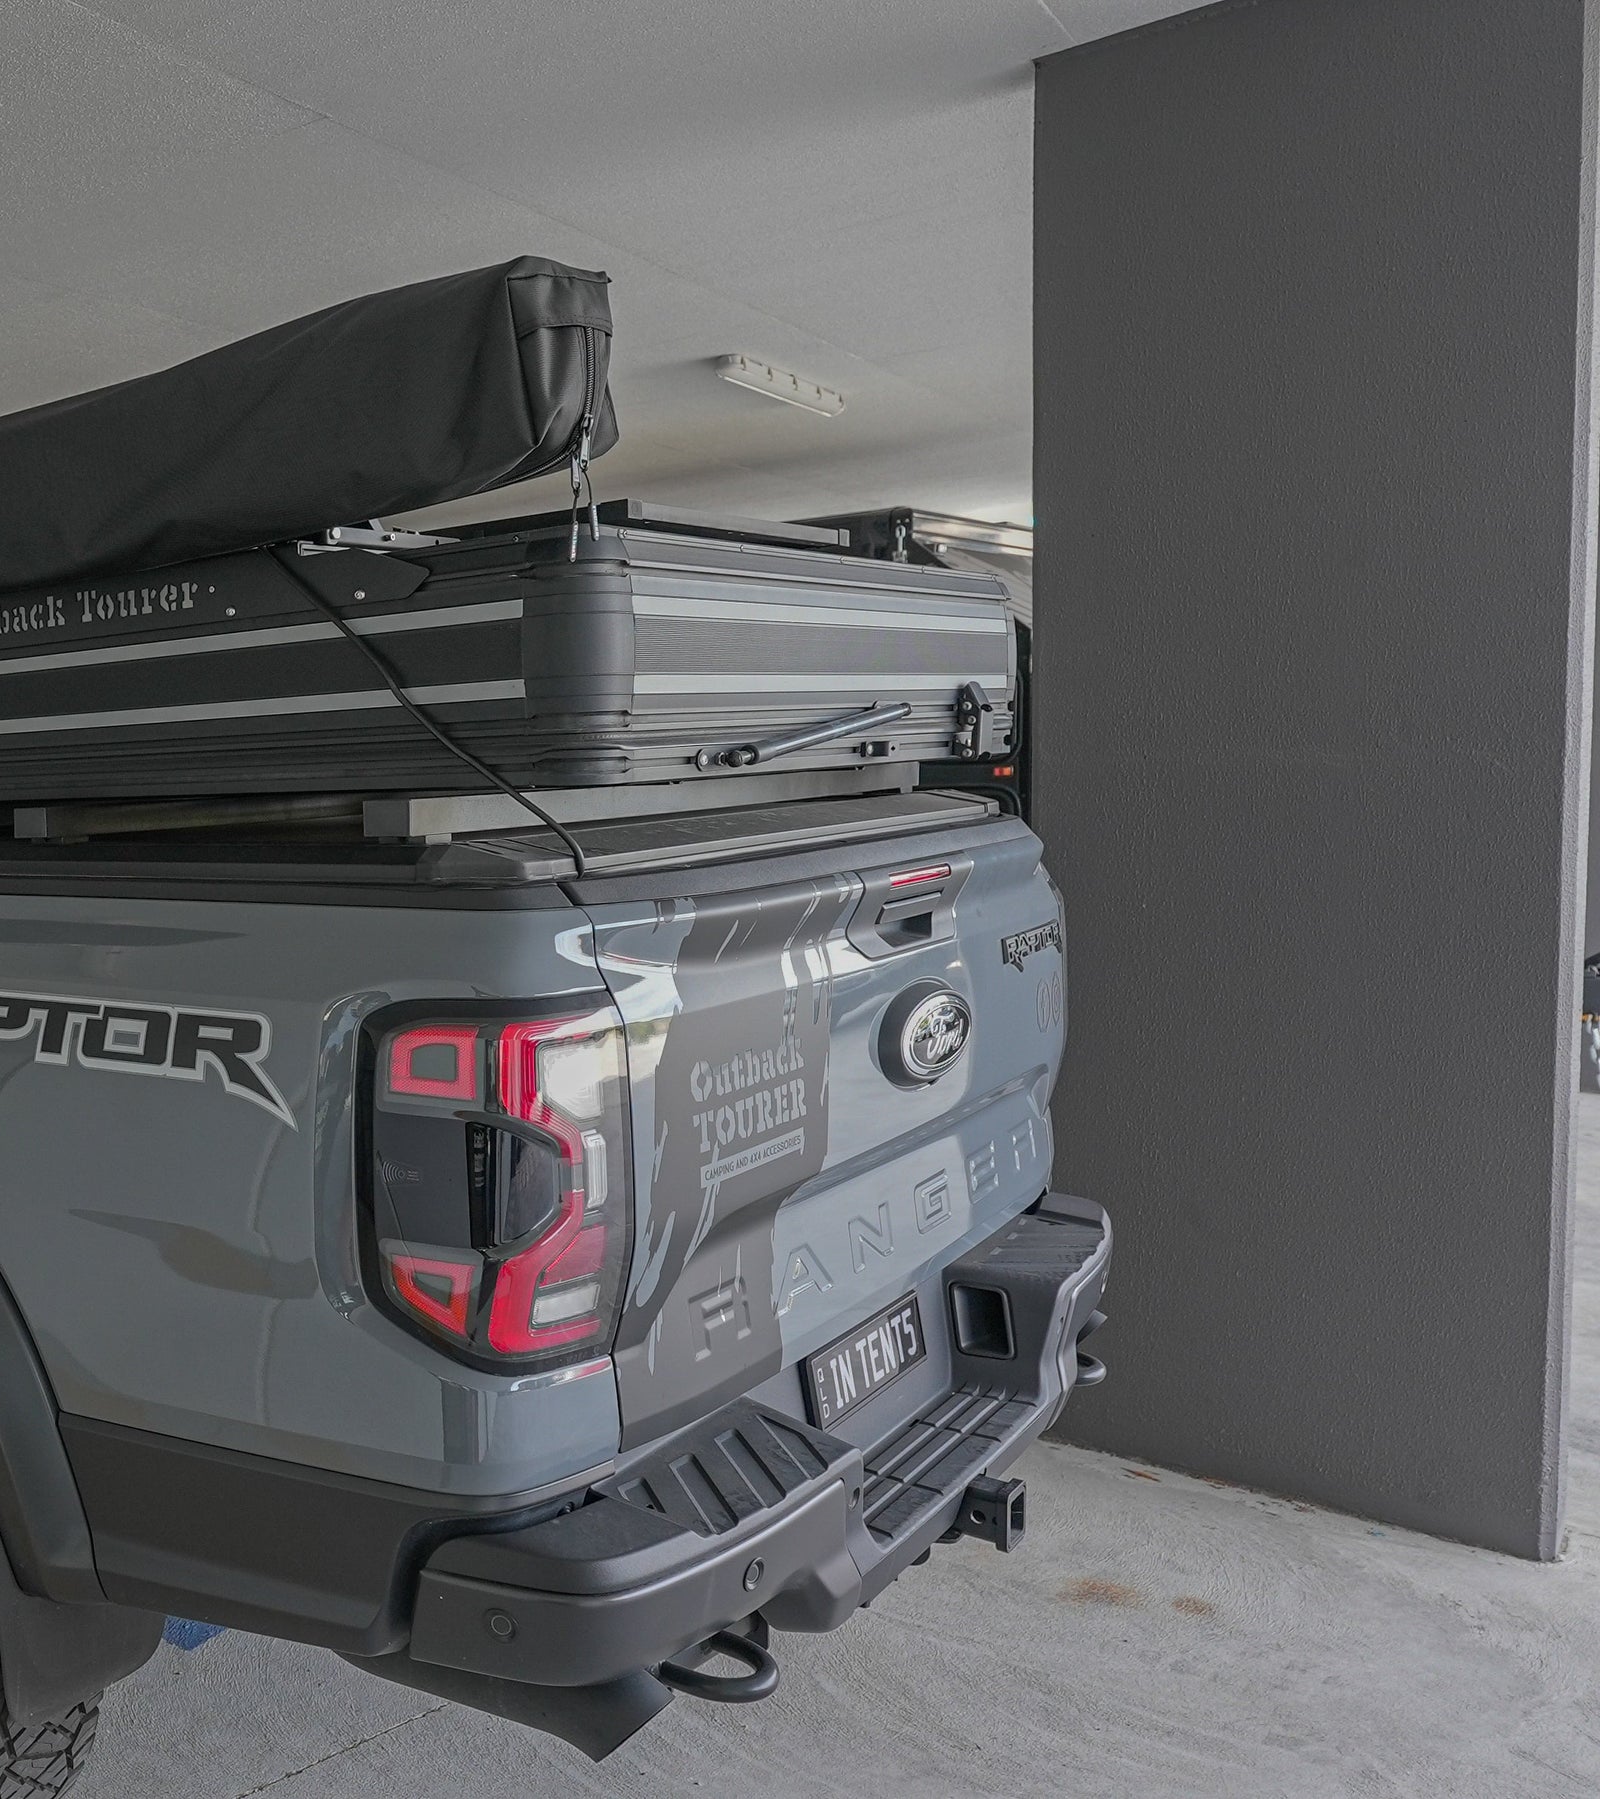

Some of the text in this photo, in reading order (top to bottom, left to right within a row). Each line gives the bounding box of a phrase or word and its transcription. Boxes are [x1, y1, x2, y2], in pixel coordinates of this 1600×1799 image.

[76, 582, 198, 623] Tourer
[1000, 918, 1063, 973] RAPTOR
[926, 1012, 964, 1060] Ford
[690, 1036, 805, 1102] Outback
[692, 1078, 807, 1153] TOURER
[704, 1163, 735, 1181] CAMPING
[736, 1156, 749, 1169] AND
[763, 1135, 801, 1158] ACCESSORIES
[688, 1118, 1037, 1362] RANGER
[817, 1368, 830, 1418] QLD
[830, 1349, 856, 1409] IN
